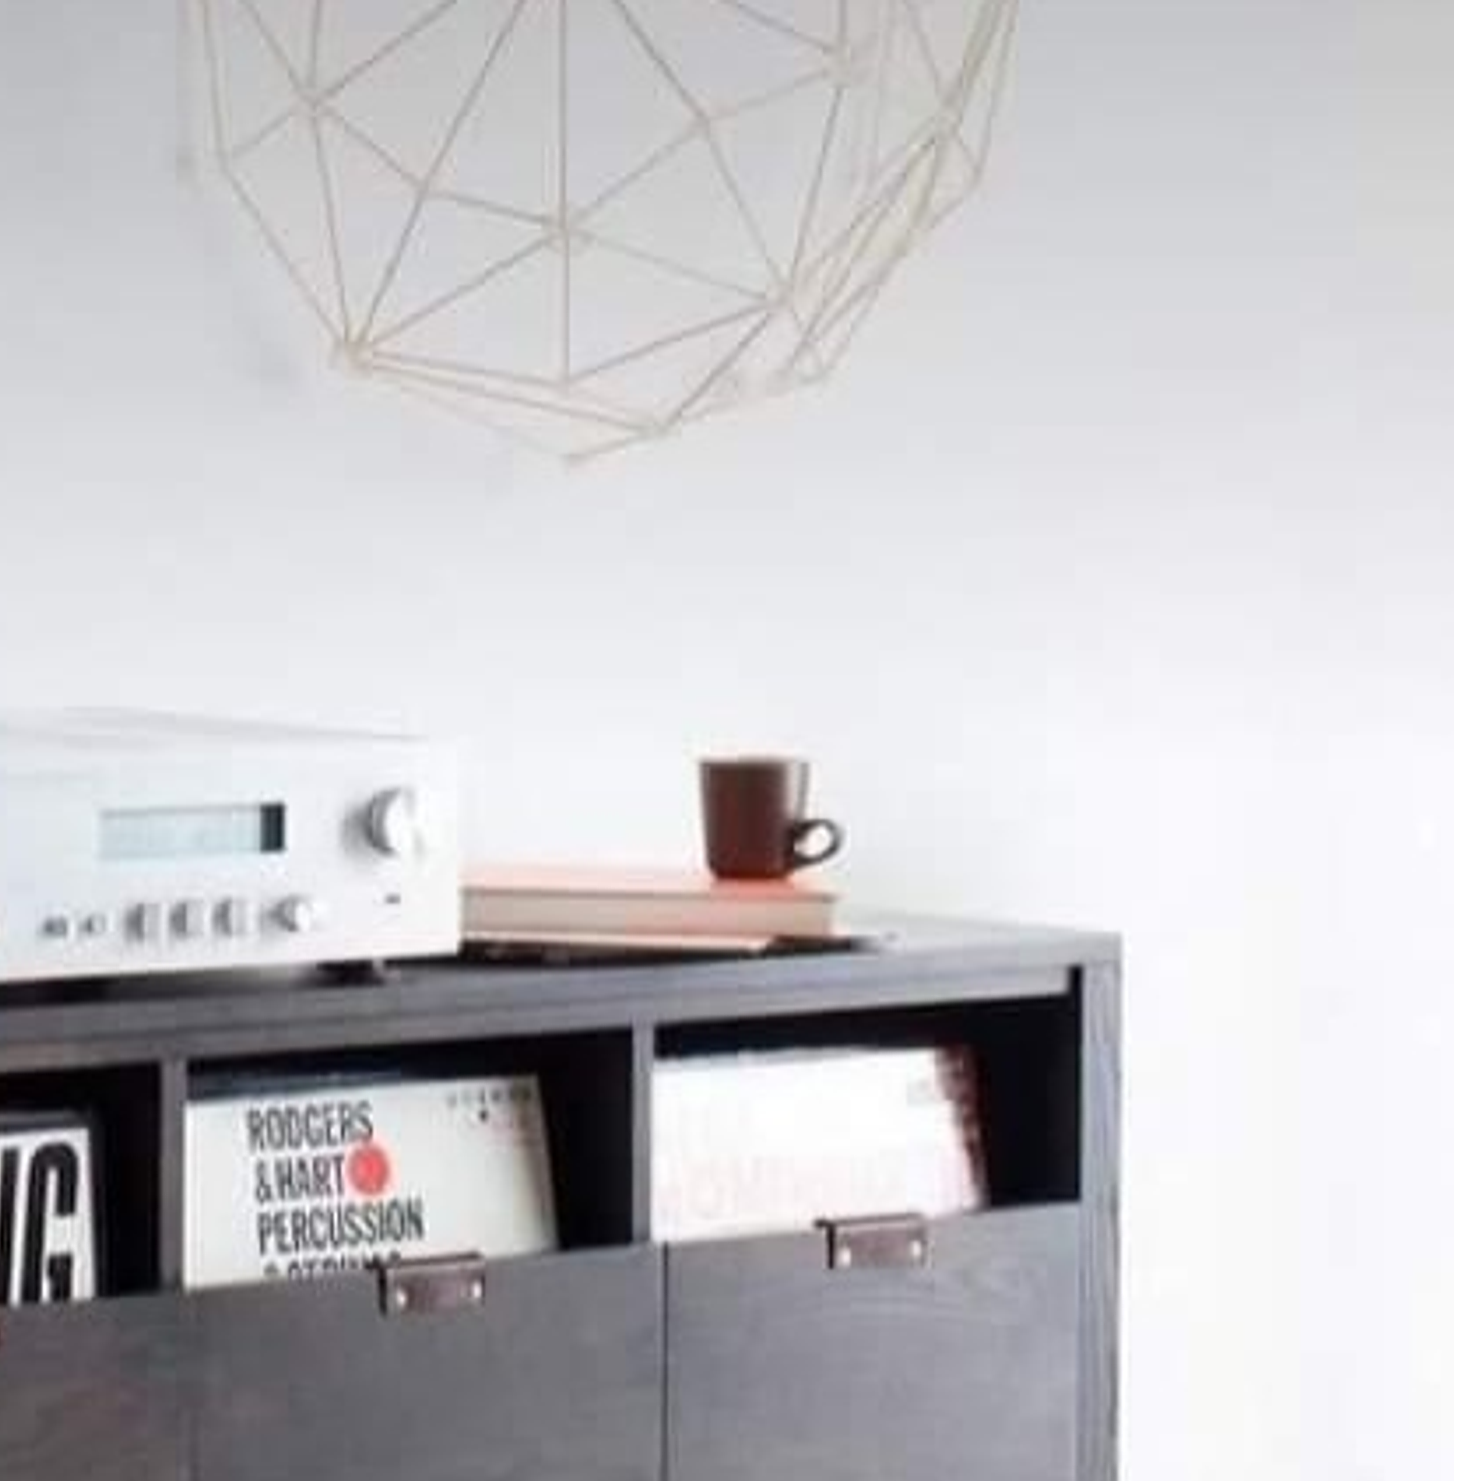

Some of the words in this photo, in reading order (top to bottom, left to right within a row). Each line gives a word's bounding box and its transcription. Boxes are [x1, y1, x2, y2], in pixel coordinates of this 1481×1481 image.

[247, 1101, 374, 1151] RODGERS
[255, 1158, 272, 1201] &
[276, 1154, 346, 1199] HART
[256, 1198, 425, 1254] PERCUSSION
